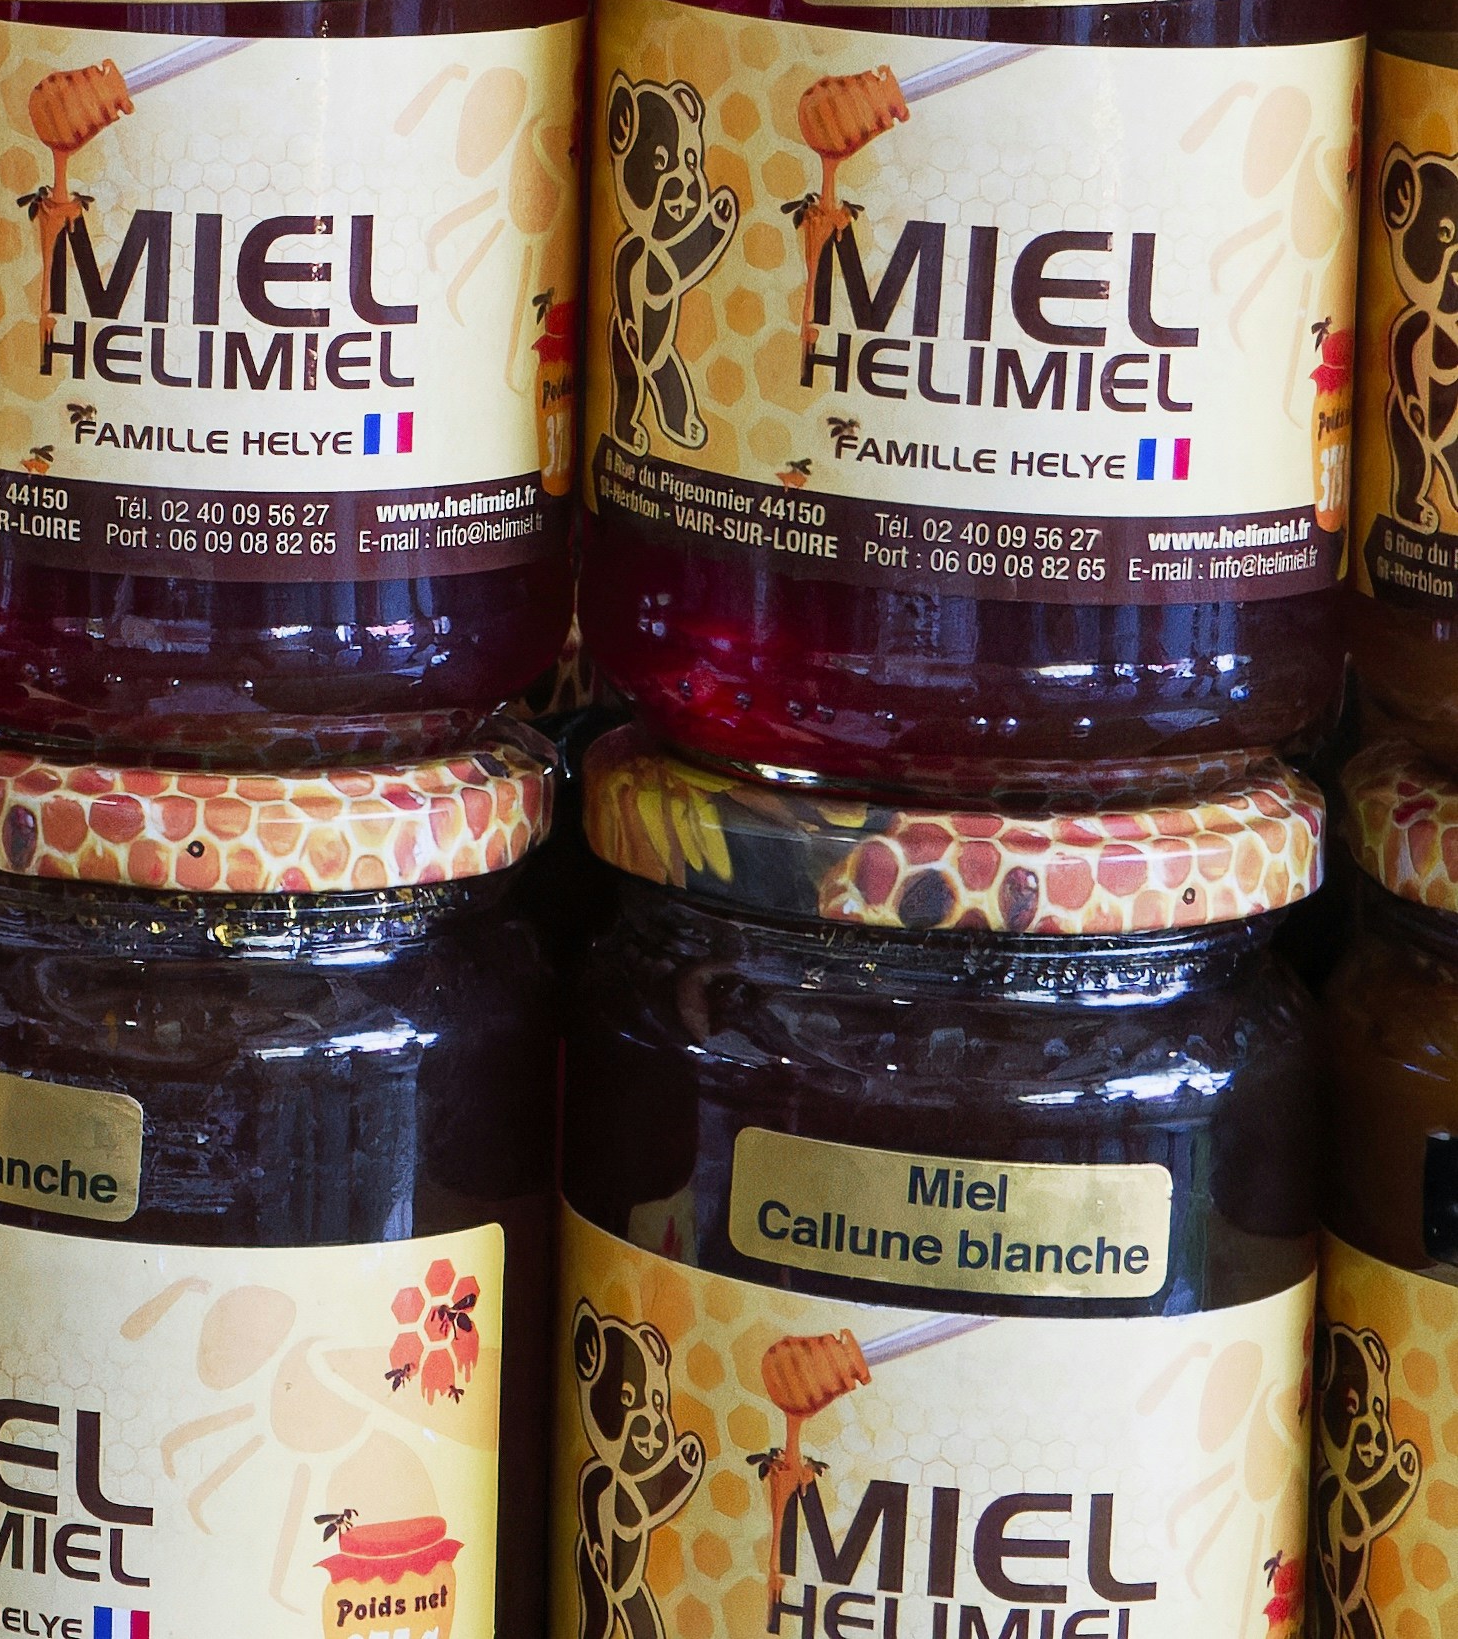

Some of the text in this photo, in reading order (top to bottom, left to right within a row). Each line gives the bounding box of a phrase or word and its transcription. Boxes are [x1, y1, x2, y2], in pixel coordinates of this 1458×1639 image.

[48, 209, 418, 328] MIEL
[813, 220, 1199, 349] MIEL
[40, 320, 415, 391] HELIMIEL
[800, 341, 1192, 413] HELIMIEL
[75, 420, 353, 456] FAMILLE HELYE
[834, 435, 1126, 481] FAMILLE HELYE
[639, 465, 656, 489] du
[660, 471, 756, 515] Pigeonnier
[759, 495, 826, 527] 44150
[675, 506, 838, 559] VAIR-SUR-LOIRE
[875, 513, 1102, 551] Tél. 02 40 09 56 27
[1148, 517, 1312, 551] www.helimiel.fr
[1128, 557, 1193, 581] E-mail
[1210, 545, 1318, 579] info@helimiel.fr
[908, 1165, 1008, 1212] Miel
[757, 1200, 1149, 1275] Callune blanche
[779, 1477, 1157, 1604] MIEL
